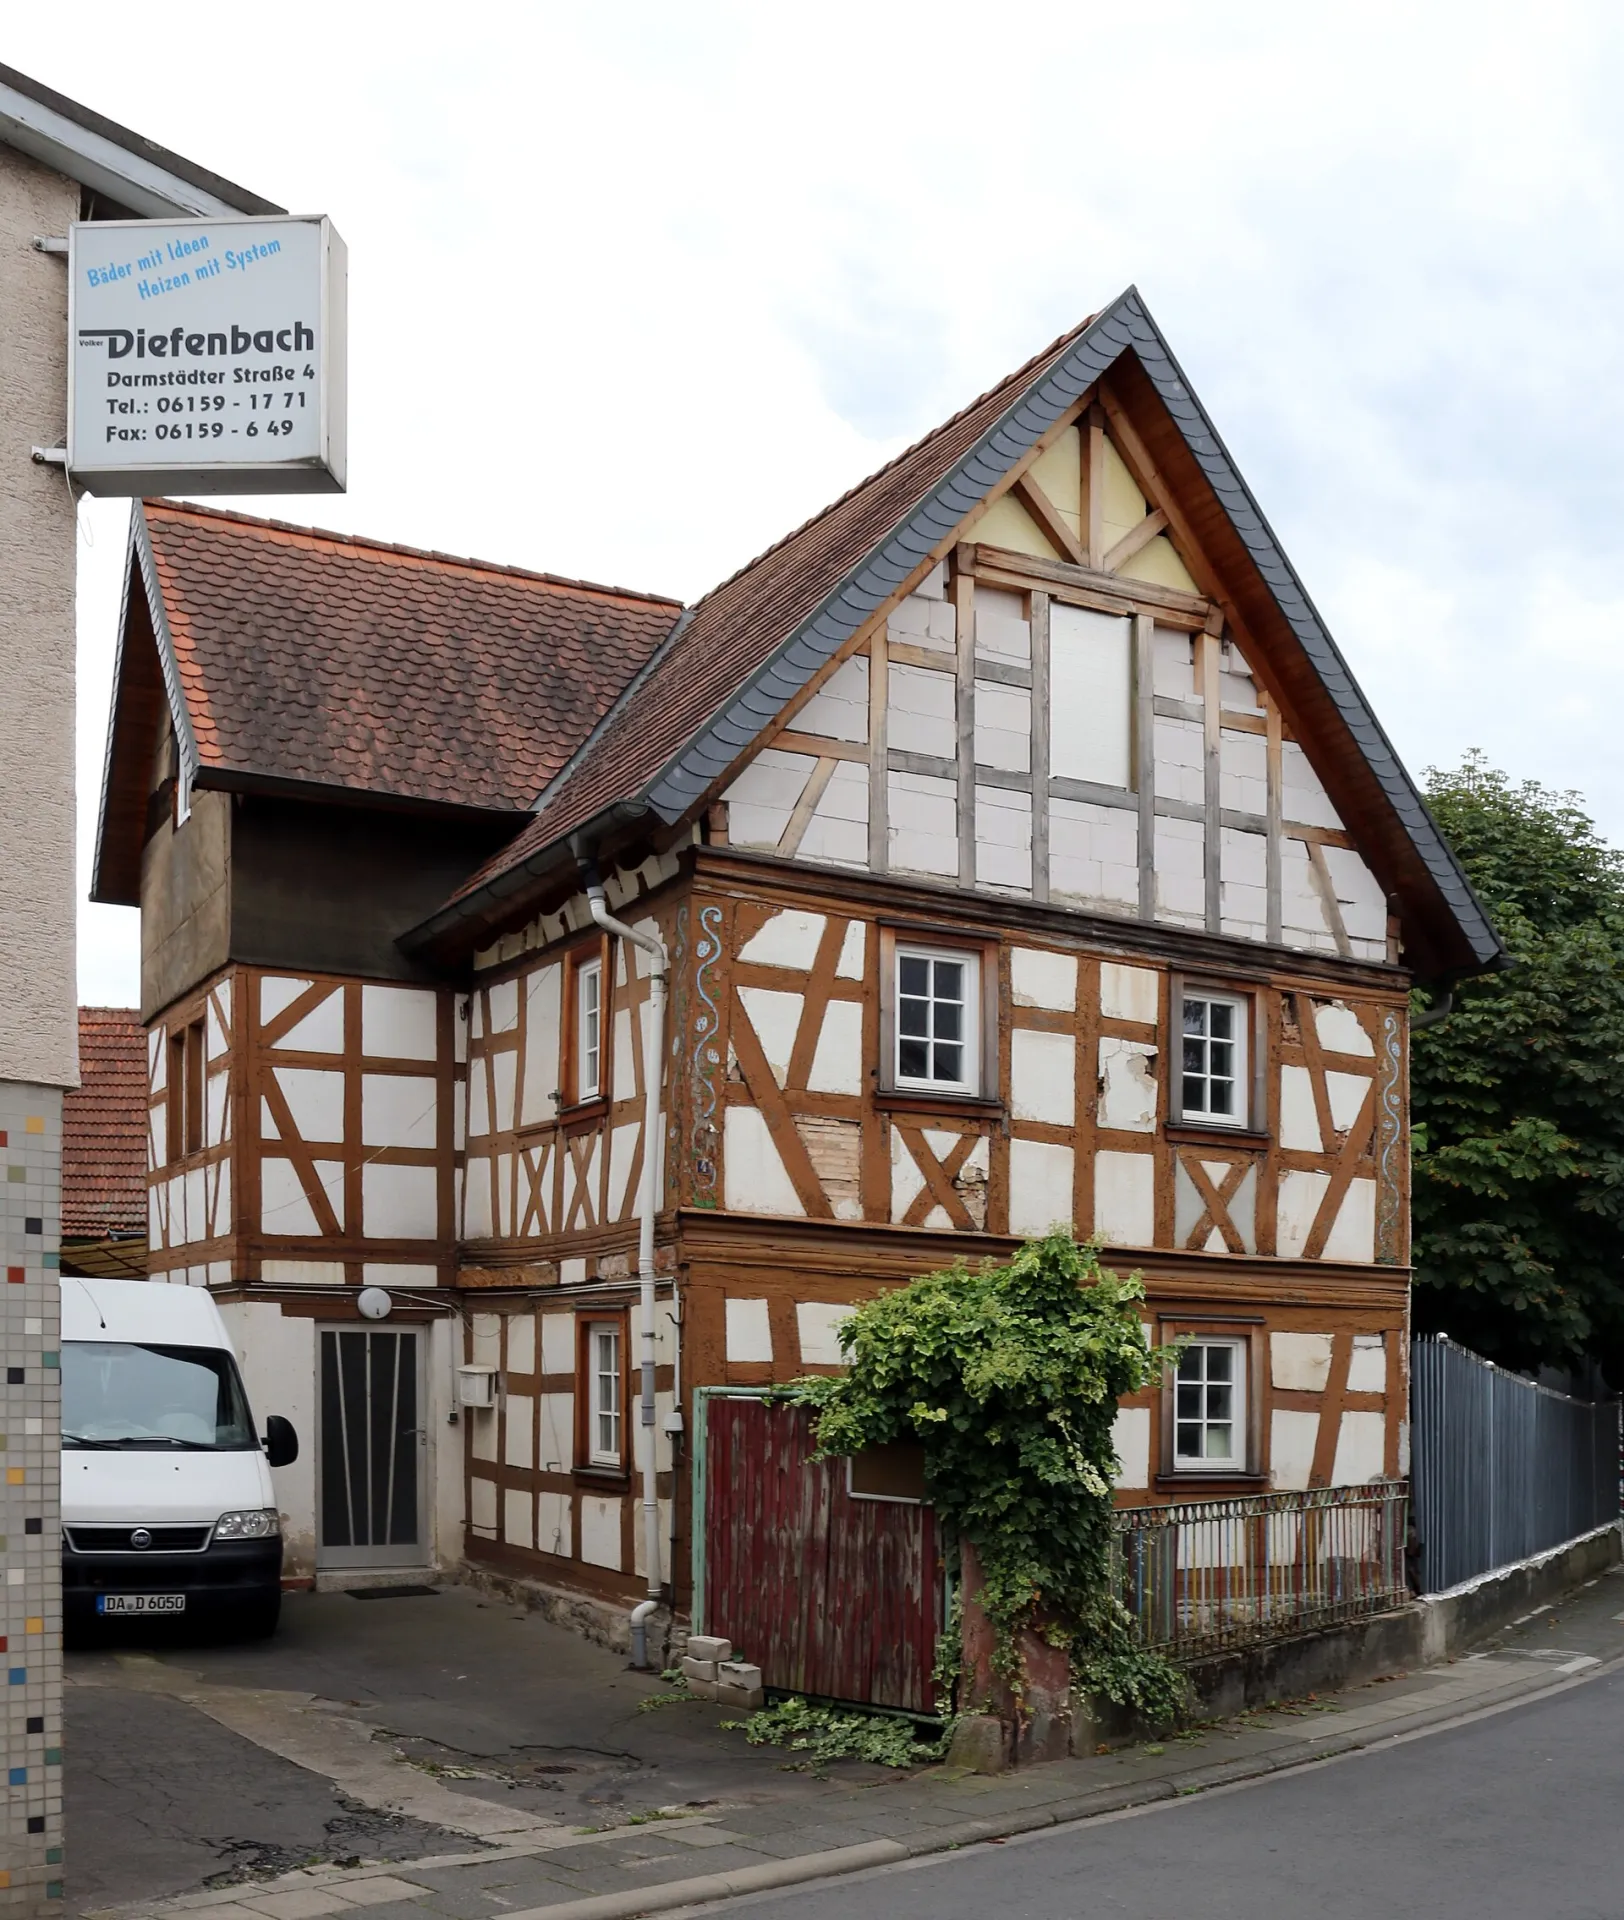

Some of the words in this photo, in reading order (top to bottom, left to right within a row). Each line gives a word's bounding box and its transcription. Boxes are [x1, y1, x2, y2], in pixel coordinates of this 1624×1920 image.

[87, 262, 132, 288] Bäder
[137, 250, 163, 272] mit
[167, 236, 210, 261] Ideen
[137, 271, 191, 300] Heizen
[195, 258, 221, 281] mit
[225, 239, 282, 271] System
[79, 322, 314, 358] Diefenbach
[107, 370, 226, 388] Darmstädter
[233, 365, 296, 384] Straße
[303, 364, 315, 380] 4
[107, 399, 149, 415] Tel.:
[156, 395, 226, 414] 06159
[250, 393, 273, 410] 17
[283, 391, 306, 408] 71
[106, 425, 147, 443] Fax:
[155, 422, 224, 440] 06159
[246, 421, 258, 437] 6
[267, 419, 294, 436] 49
[106, 1597, 125, 1610] DA
[135, 1597, 145, 1610] D
[148, 1596, 184, 1610] 6050
